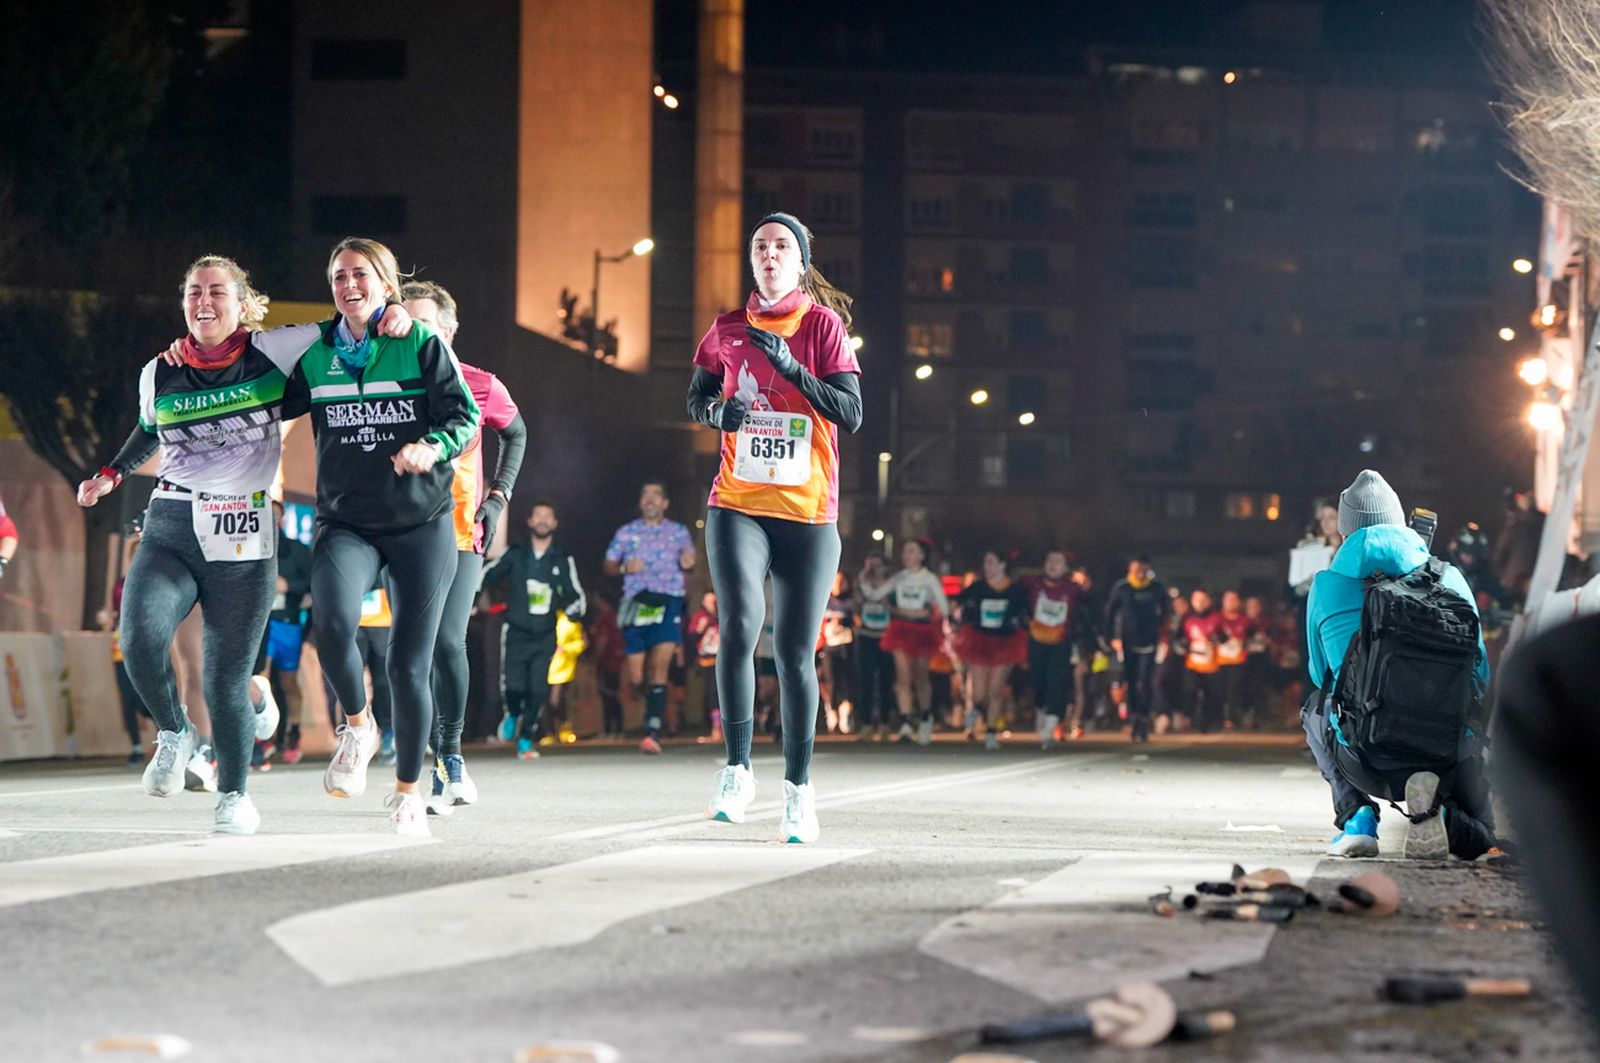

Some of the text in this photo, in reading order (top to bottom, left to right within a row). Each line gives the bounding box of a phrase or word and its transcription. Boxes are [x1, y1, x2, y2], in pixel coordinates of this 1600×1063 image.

[173, 386, 250, 411] SERMAN
[325, 400, 415, 420] SERMAN
[366, 414, 416, 425] MARBELLA
[773, 420, 783, 428] DE
[744, 427, 759, 435] SAN
[341, 433, 395, 444] MARBELLA
[751, 437, 795, 459] 6351
[203, 503, 220, 512] SAN
[211, 511, 259, 535] 7025
